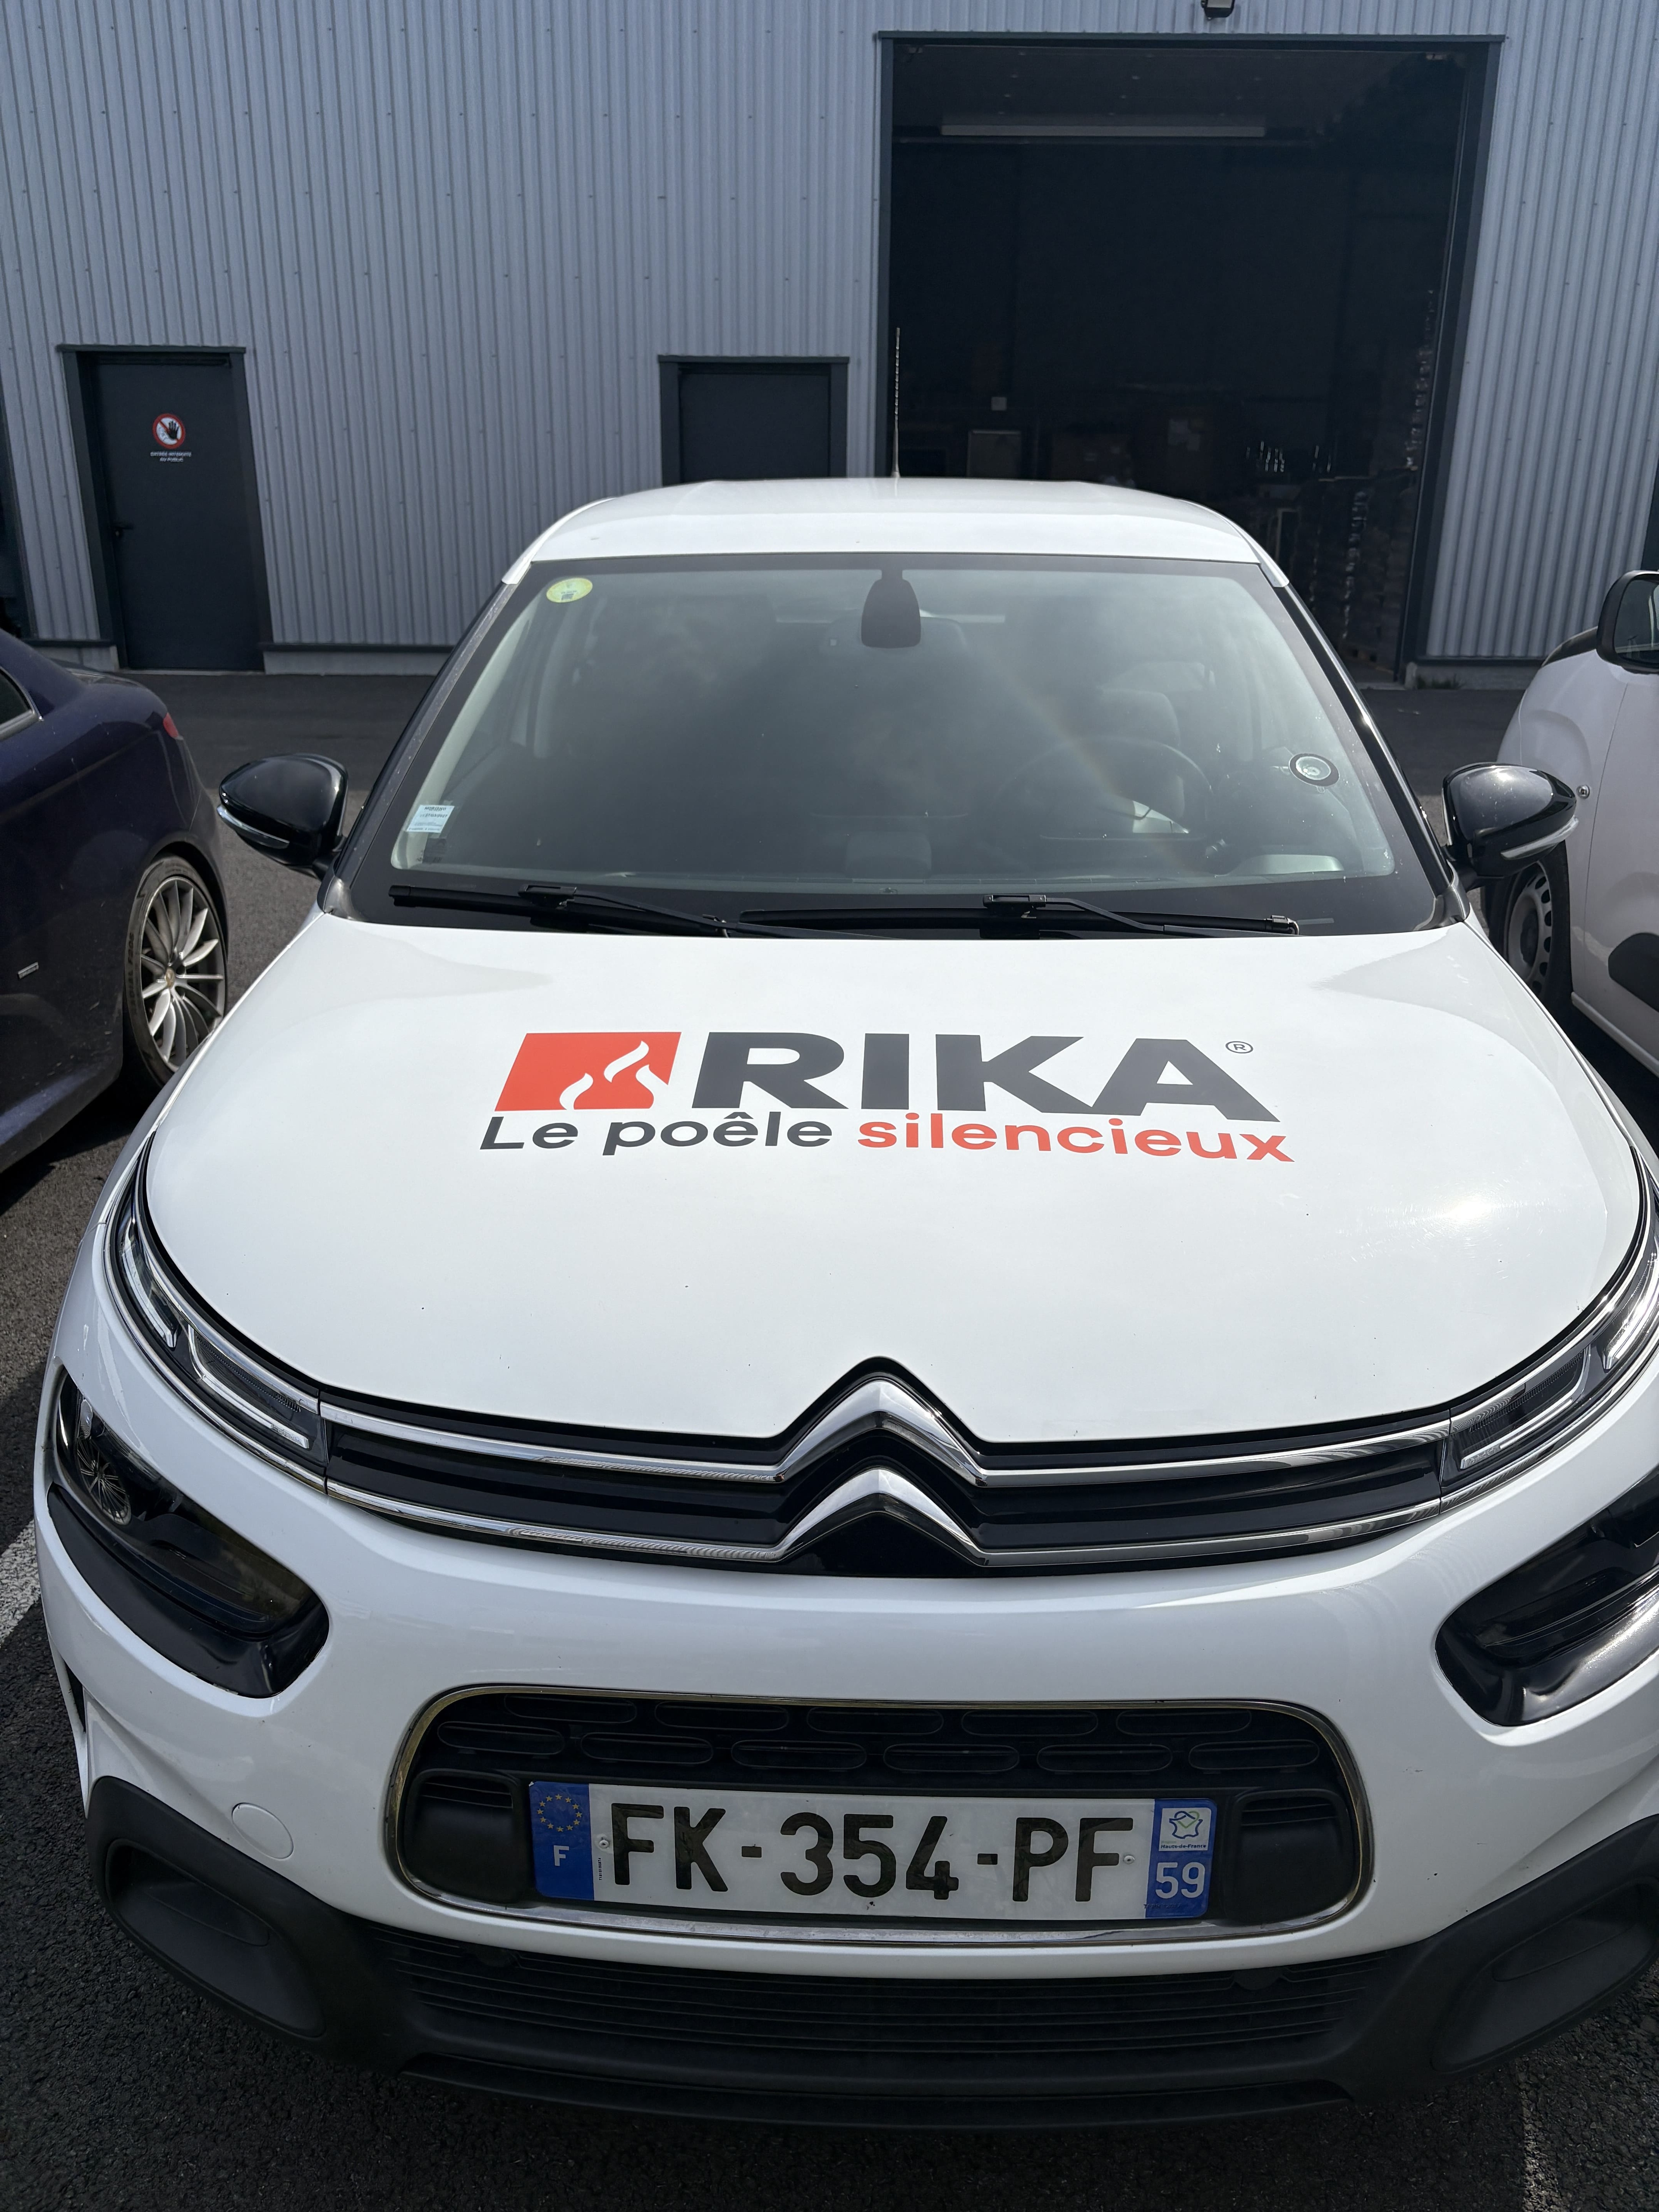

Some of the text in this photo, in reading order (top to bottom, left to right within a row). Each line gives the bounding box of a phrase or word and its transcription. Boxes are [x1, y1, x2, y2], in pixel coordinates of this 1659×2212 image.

[692, 1032, 1280, 1122] RIKA
[480, 1112, 1294, 1162] Le poêle silencieux
[553, 1845, 569, 1866] F
[611, 1803, 1133, 1902] FK-354-PF
[1155, 1862, 1206, 1899] 59
